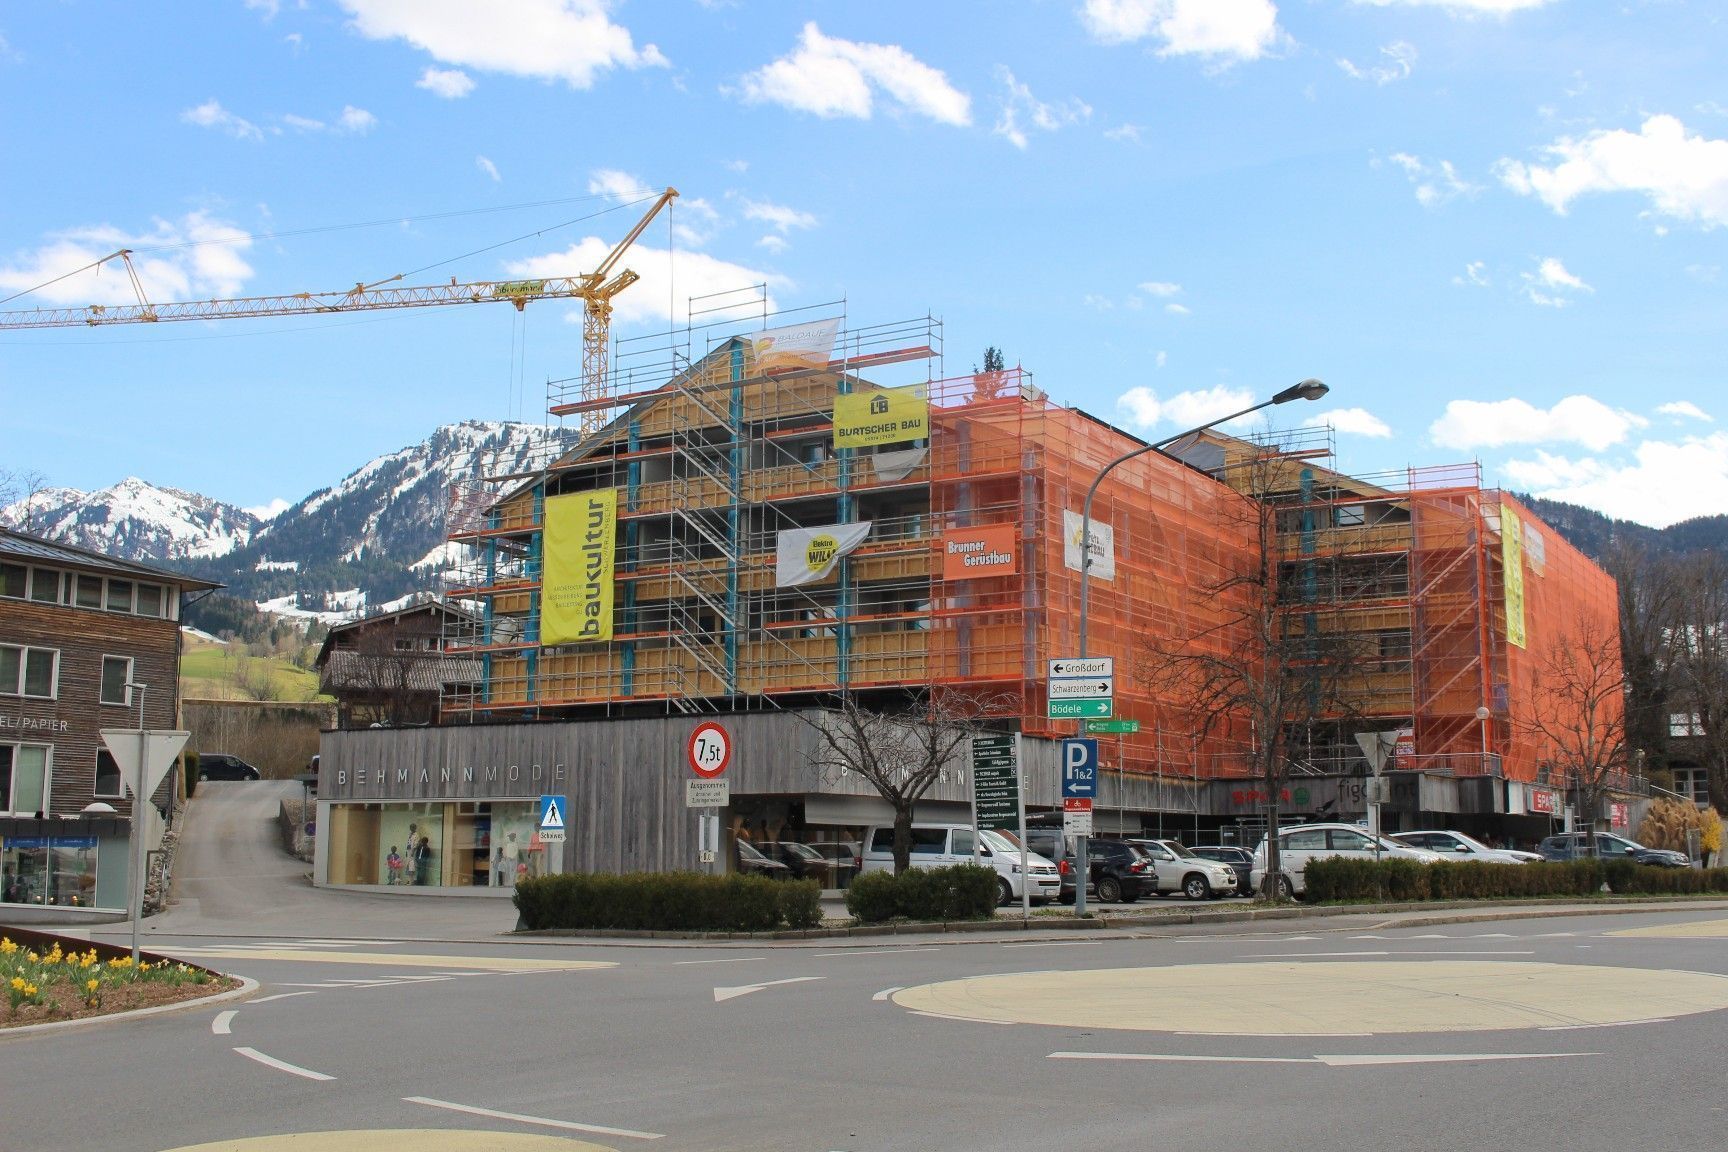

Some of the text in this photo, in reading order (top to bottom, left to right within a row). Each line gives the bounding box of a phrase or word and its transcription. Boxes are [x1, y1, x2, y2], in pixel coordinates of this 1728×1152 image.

[838, 418, 921, 437] BURTSCHER BAU
[812, 540, 833, 548] Elektro
[947, 540, 986, 555] Brunner
[963, 550, 1012, 567] Gerüstbau
[578, 498, 604, 637] baukultur
[1065, 662, 1106, 673] Großdorf
[1052, 684, 1097, 694] Schwarzenberg
[1051, 704, 1082, 714] Bödele
[697, 738, 721, 764] 7,5t
[1066, 742, 1093, 780] P 1&2
[841, 759, 964, 785] BMNN
